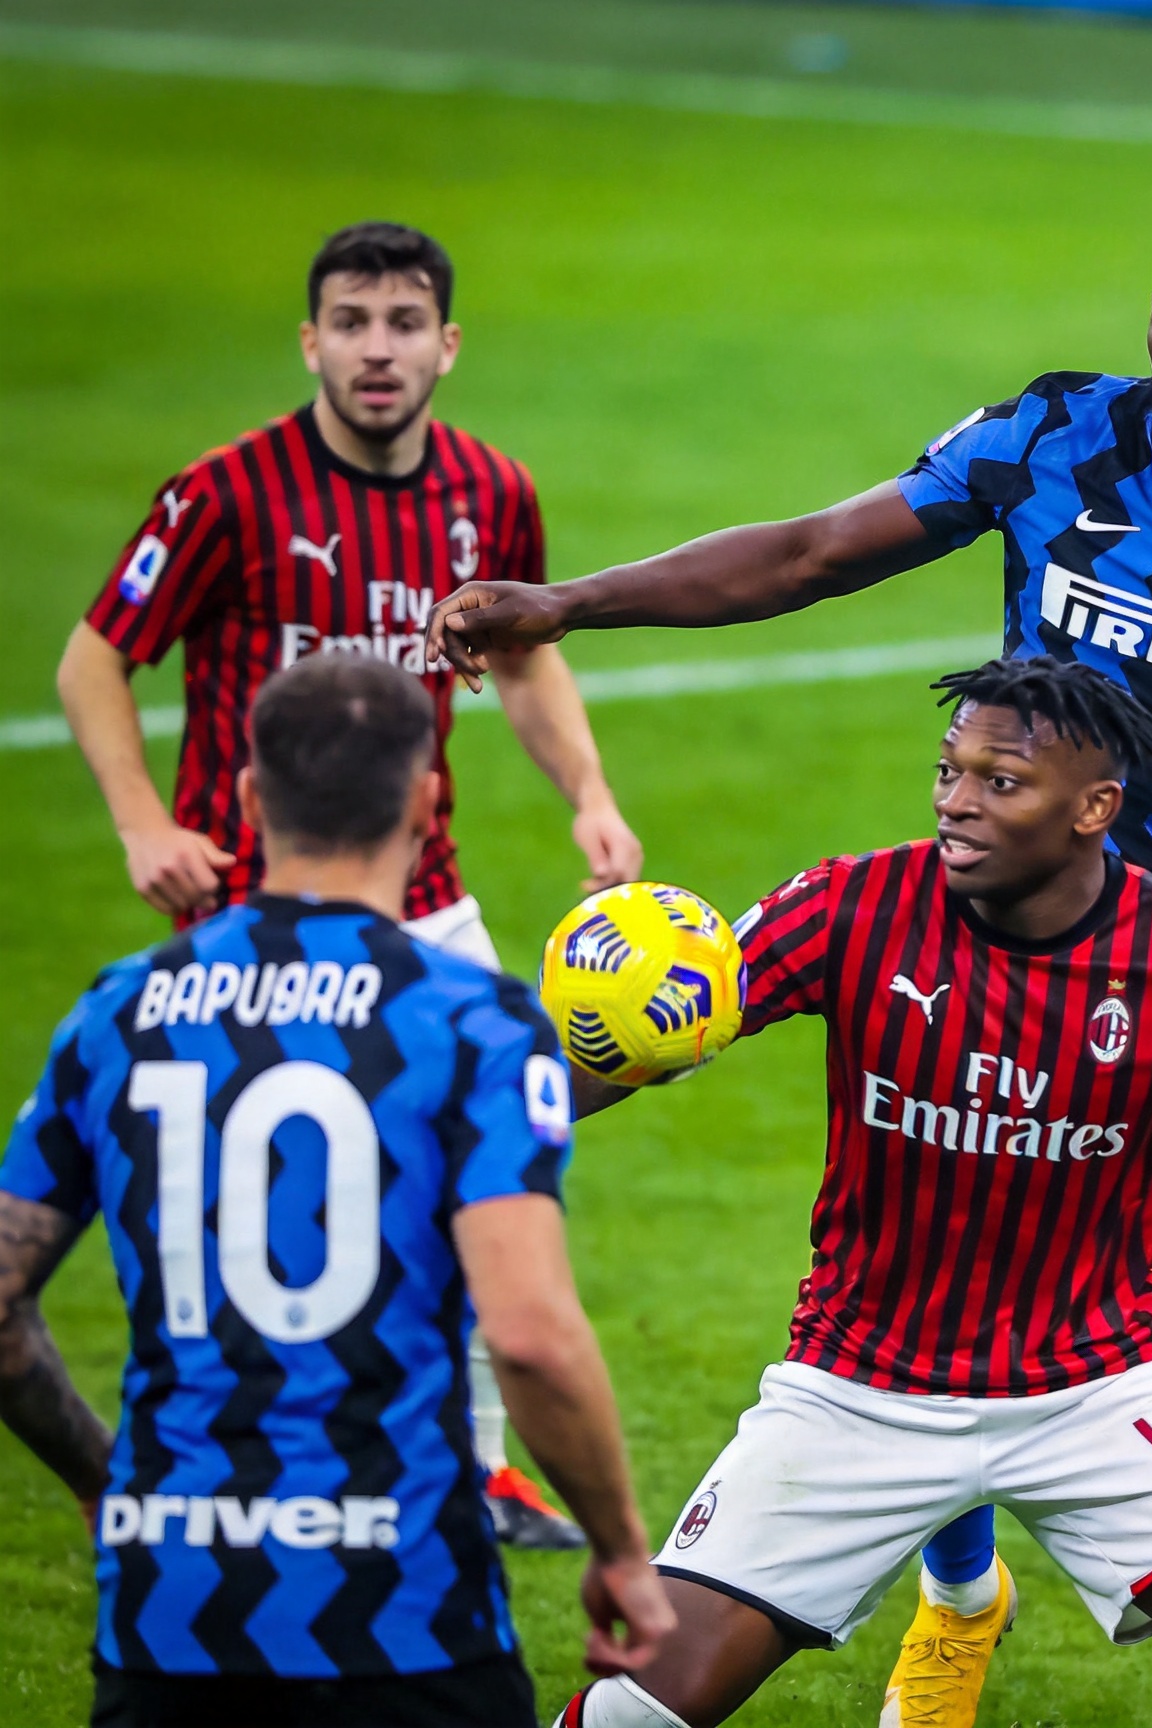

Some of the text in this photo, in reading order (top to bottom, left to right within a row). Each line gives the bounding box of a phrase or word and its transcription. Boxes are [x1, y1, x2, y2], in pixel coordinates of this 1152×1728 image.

[368, 580, 434, 629] Fly
[863, 1070, 1129, 1162] Emirates
[965, 1052, 1049, 1109] Fly
[129, 1060, 379, 1344] 10
